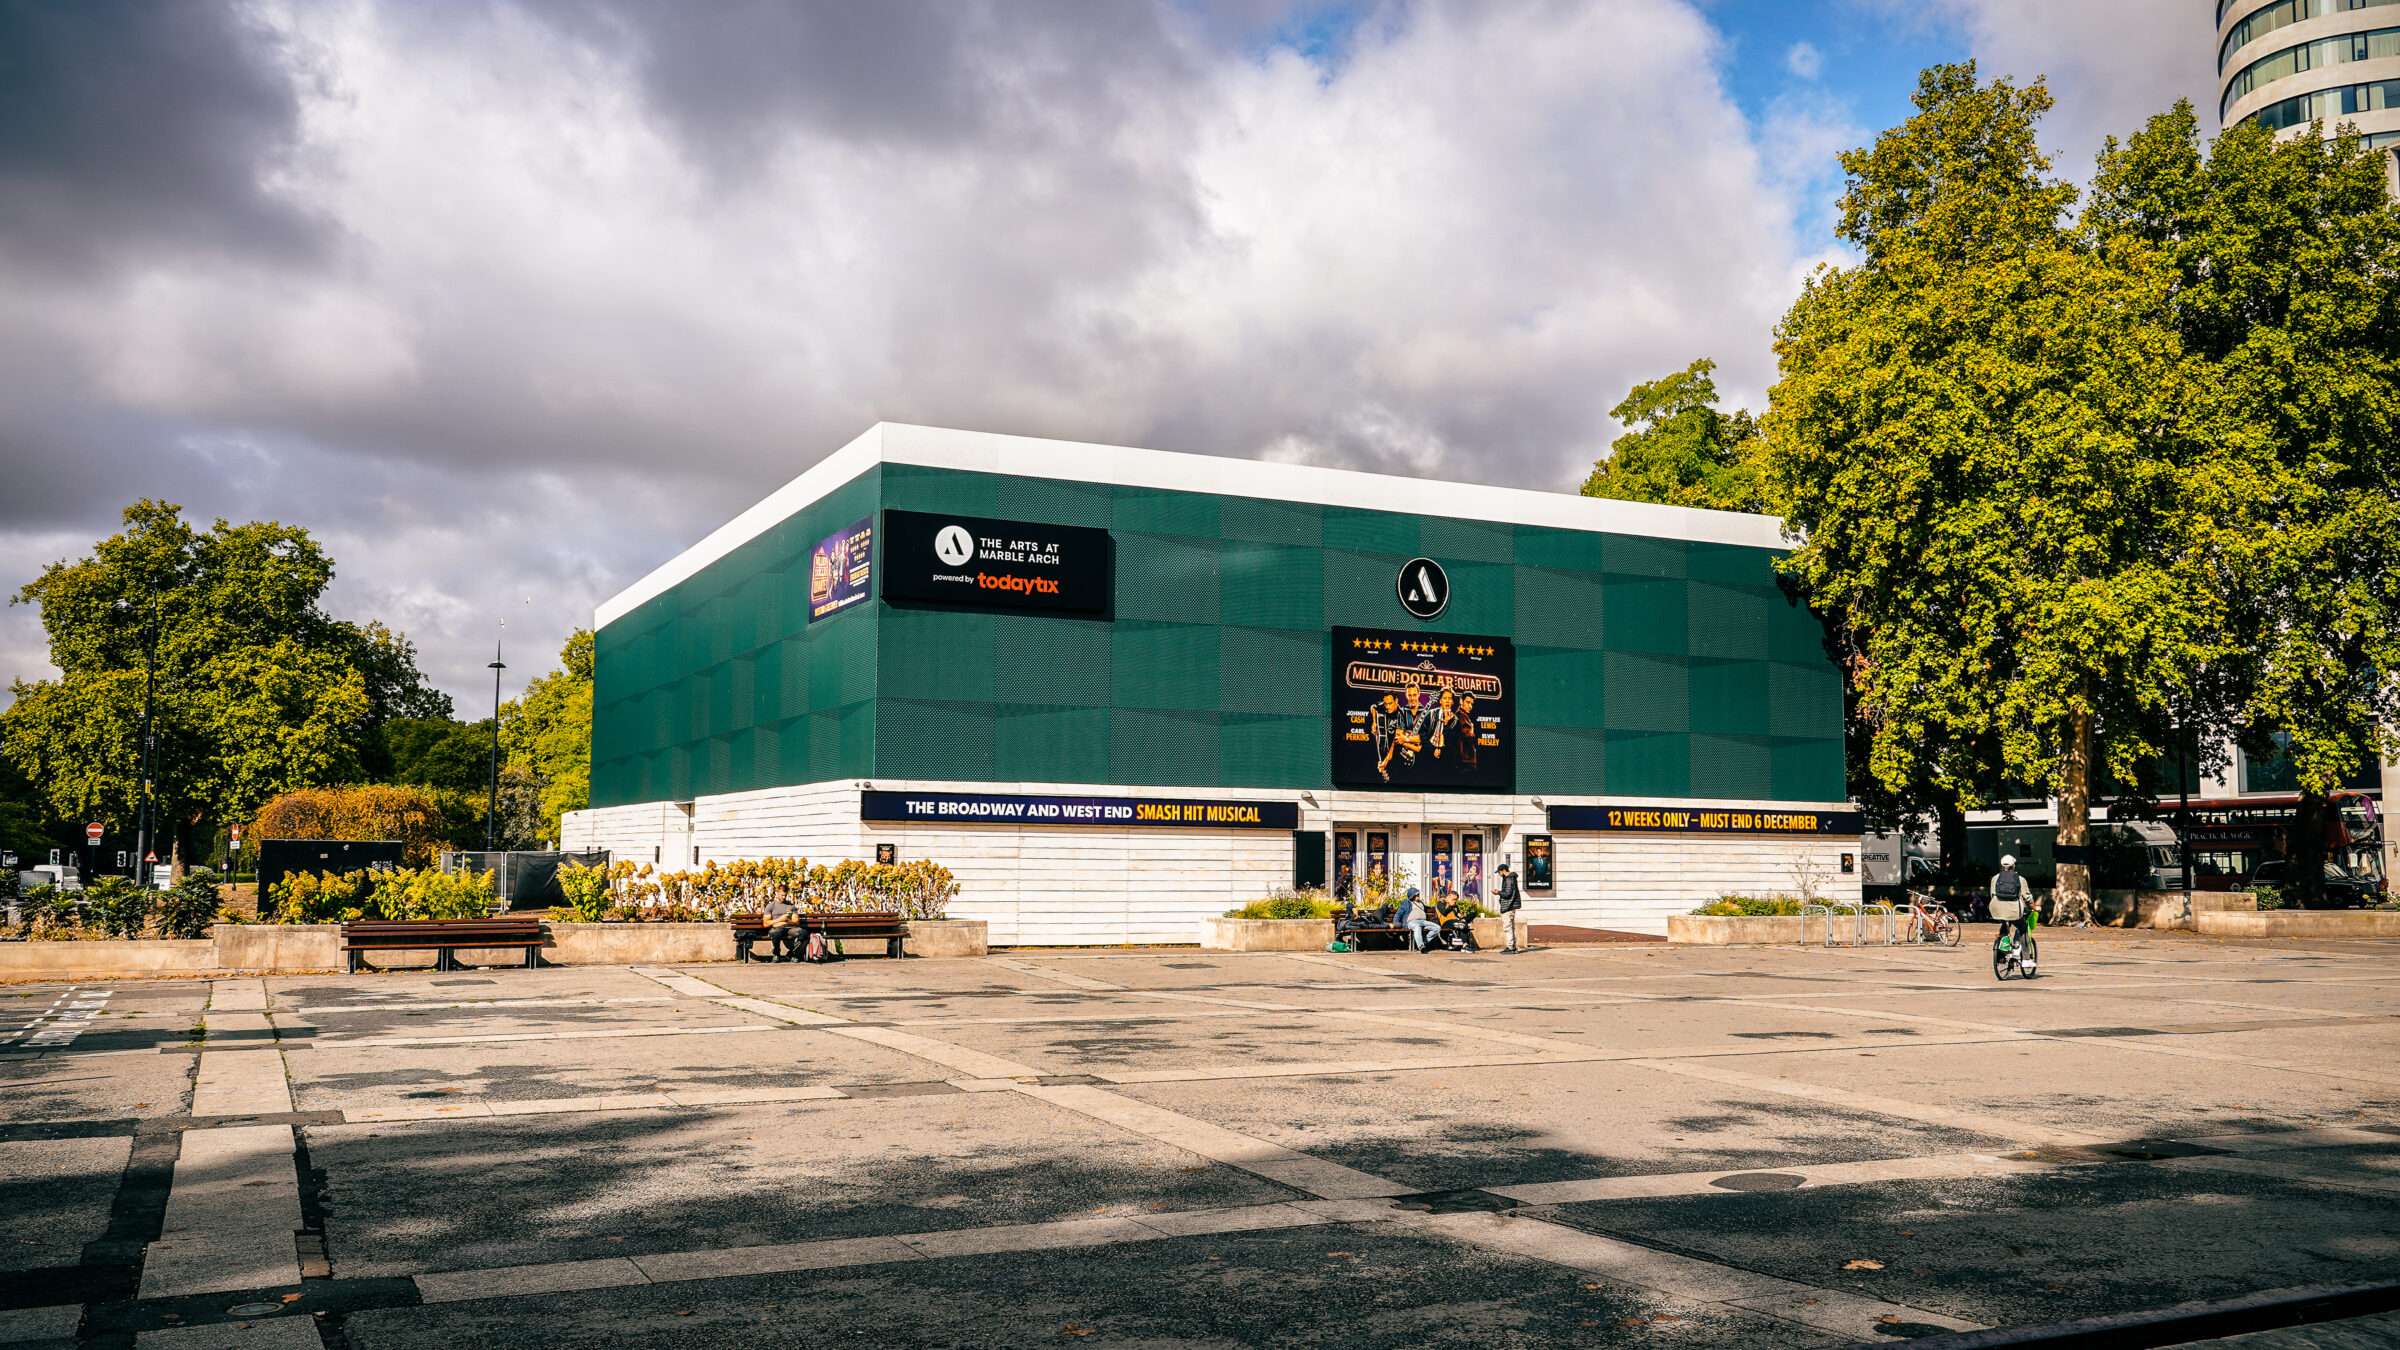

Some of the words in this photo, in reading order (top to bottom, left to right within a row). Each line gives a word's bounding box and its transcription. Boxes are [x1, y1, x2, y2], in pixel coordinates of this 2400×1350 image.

[980, 537, 1002, 549] THE
[1009, 540, 1039, 552] ARTS
[1046, 543, 1060, 553] AT
[979, 549, 1025, 562] MARBLE
[1028, 554, 1060, 565] ARCH
[932, 574, 964, 583] powered
[965, 575, 975, 584] by
[977, 571, 1060, 595] todaytix
[1352, 666, 1396, 683] MILLION
[1399, 671, 1454, 688] DOLLAR
[1457, 677, 1497, 692] QUARTET
[1350, 715, 1365, 723] CASH
[1345, 733, 1370, 741] PERKINS
[905, 801, 935, 814] THE
[938, 802, 1025, 816] BROADWAY
[1027, 804, 1059, 817] AND
[1062, 805, 1102, 818] WEST
[1104, 806, 1133, 819] END
[1136, 804, 1180, 820] SMASH
[1183, 805, 1204, 821] HIT
[1207, 806, 1262, 822] MUSICAL
[1607, 811, 1621, 826] 12
[1623, 811, 1661, 827] WEEKS
[1663, 812, 1690, 827] ONLY
[1700, 813, 1730, 828] MUST
[1731, 814, 1752, 828] END
[1754, 814, 1762, 829] 6
[1763, 814, 1817, 830] DECEMBER
